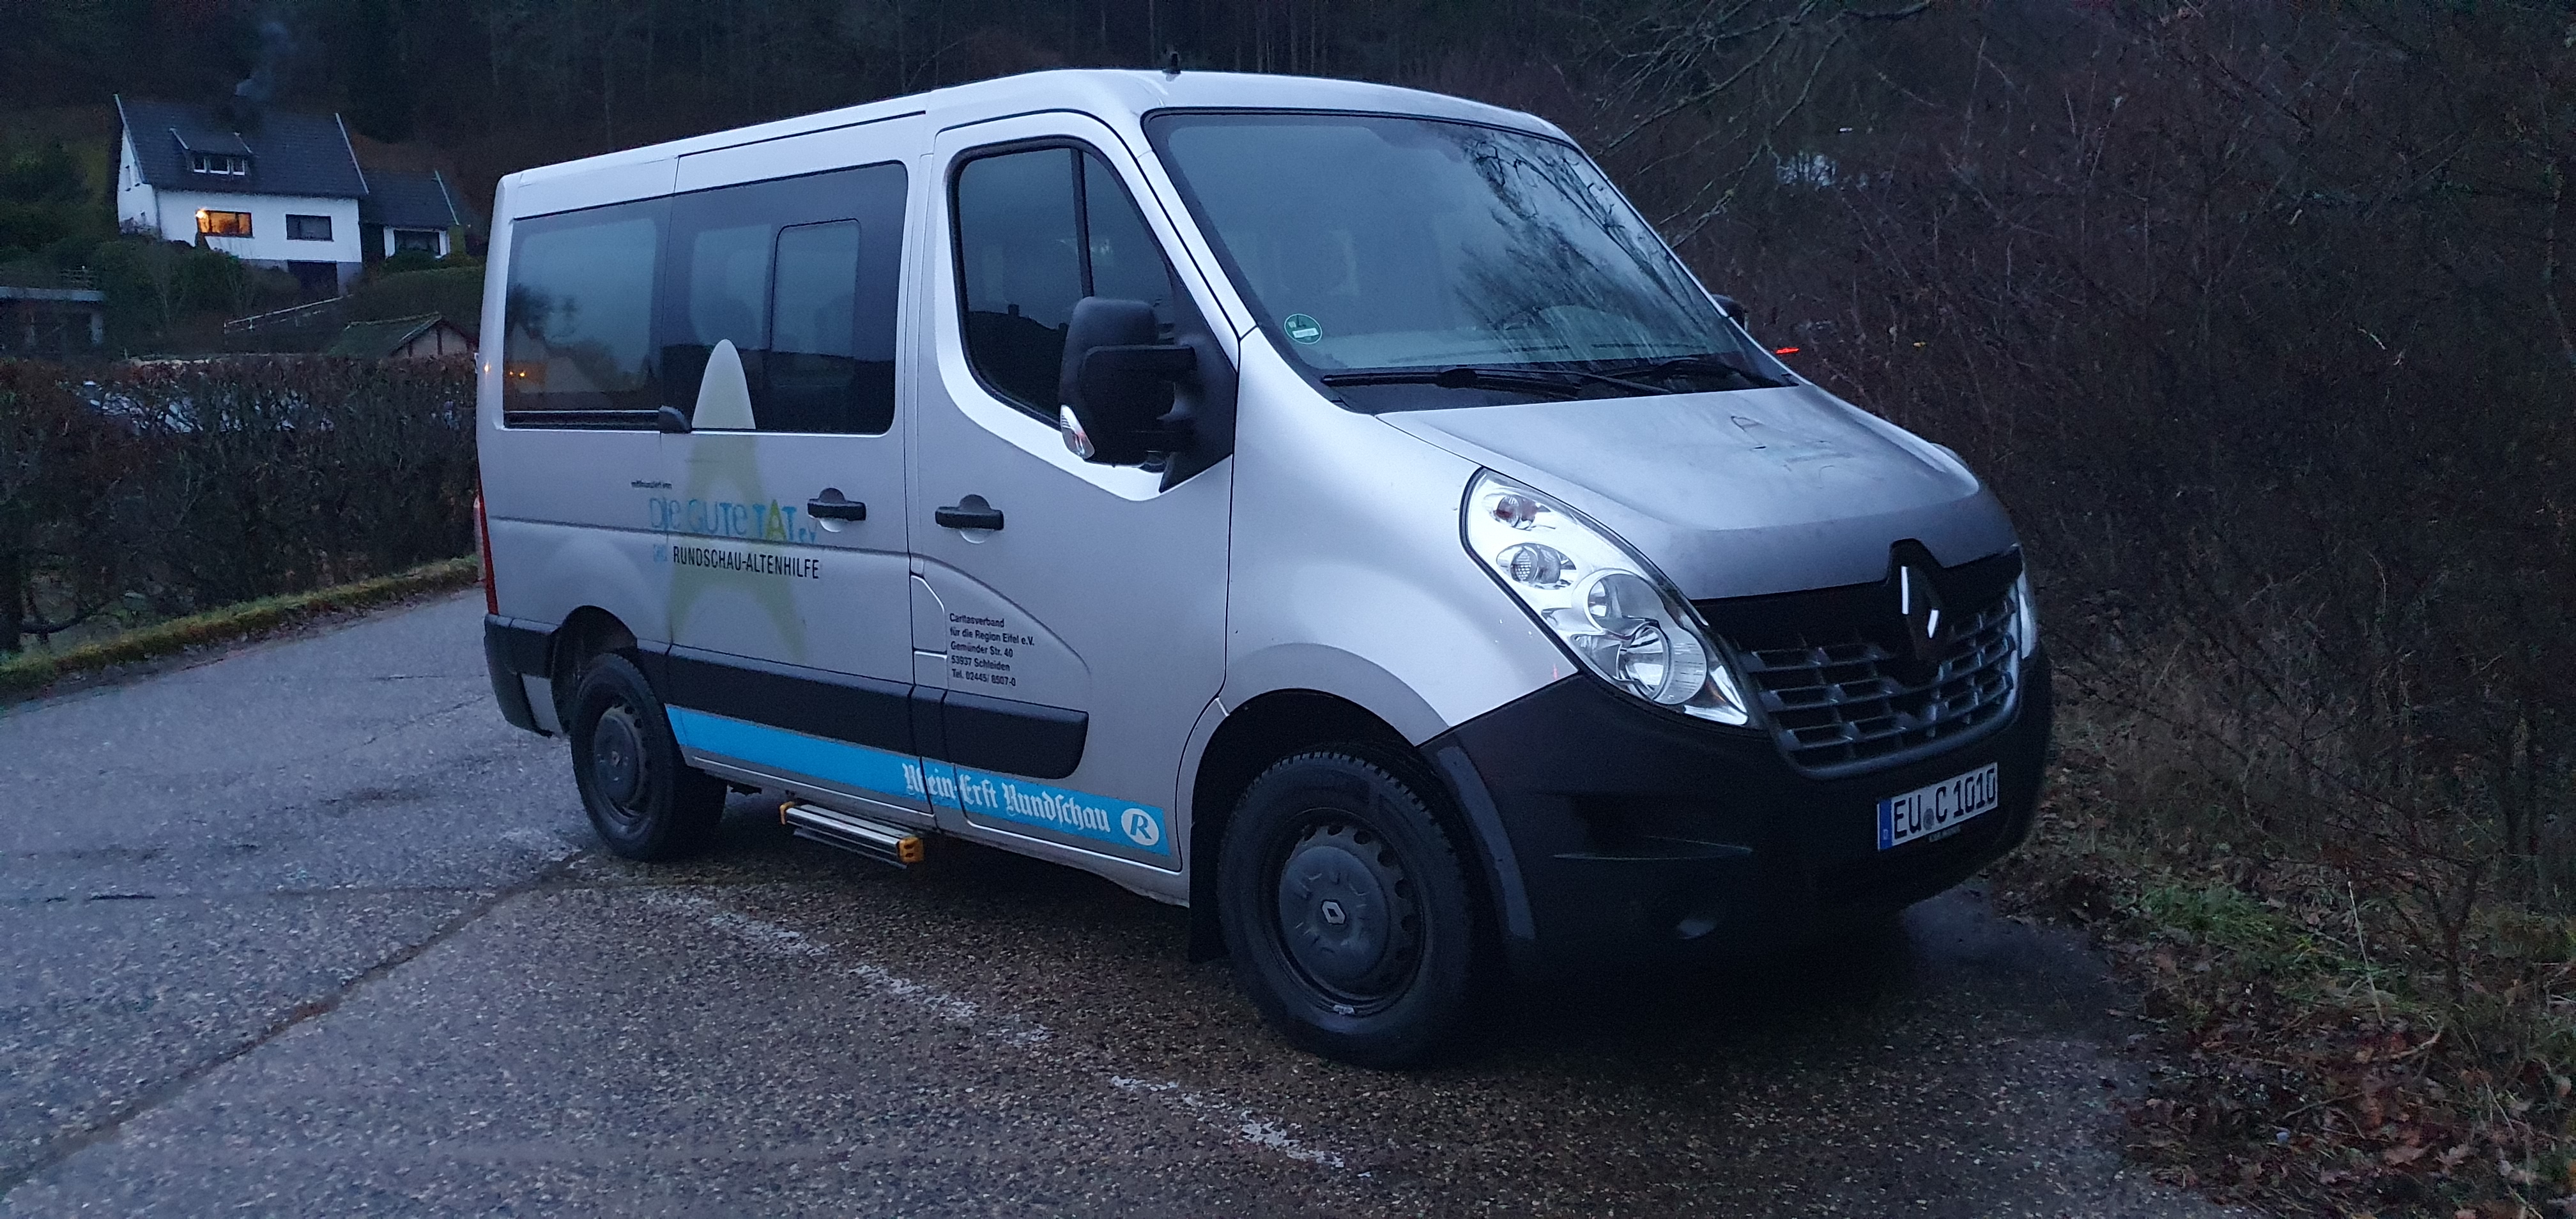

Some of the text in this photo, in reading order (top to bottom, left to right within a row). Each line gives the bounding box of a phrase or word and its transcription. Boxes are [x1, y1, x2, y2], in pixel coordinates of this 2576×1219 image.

[753, 499, 797, 543] TAT
[673, 545, 820, 579] RUNDSCHAU-ALTENHILFE
[949, 613, 1005, 628] Caritasverband
[950, 627, 1034, 647] für die Region Eifel e.V.
[950, 640, 1013, 657] Gemünder Str. 40
[951, 655, 1011, 671] 53937 Schleiden
[951, 668, 965, 679] Tel.
[1893, 767, 1996, 839] EU C 1010
